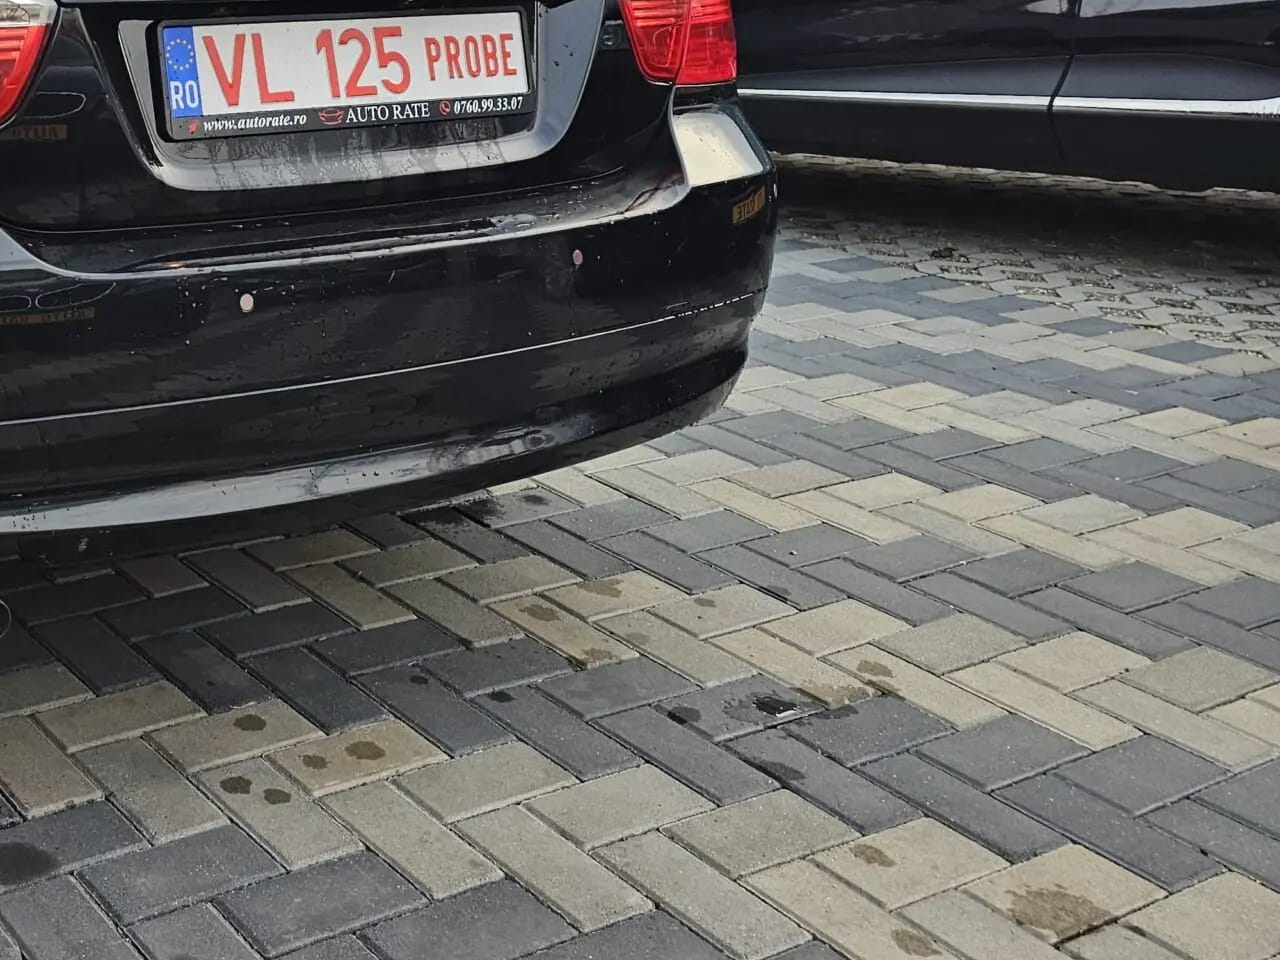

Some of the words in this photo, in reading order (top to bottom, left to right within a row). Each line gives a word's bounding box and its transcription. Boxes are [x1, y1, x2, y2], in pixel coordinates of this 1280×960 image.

[202, 33, 295, 107] VL
[316, 26, 412, 99] 125
[424, 33, 518, 82] PROBE
[170, 80, 199, 110] RO
[203, 113, 307, 132] www.autorate.ro
[345, 105, 389, 124] AUTO
[392, 102, 430, 120] RATE
[453, 96, 523, 115] 0760.99.33.07
